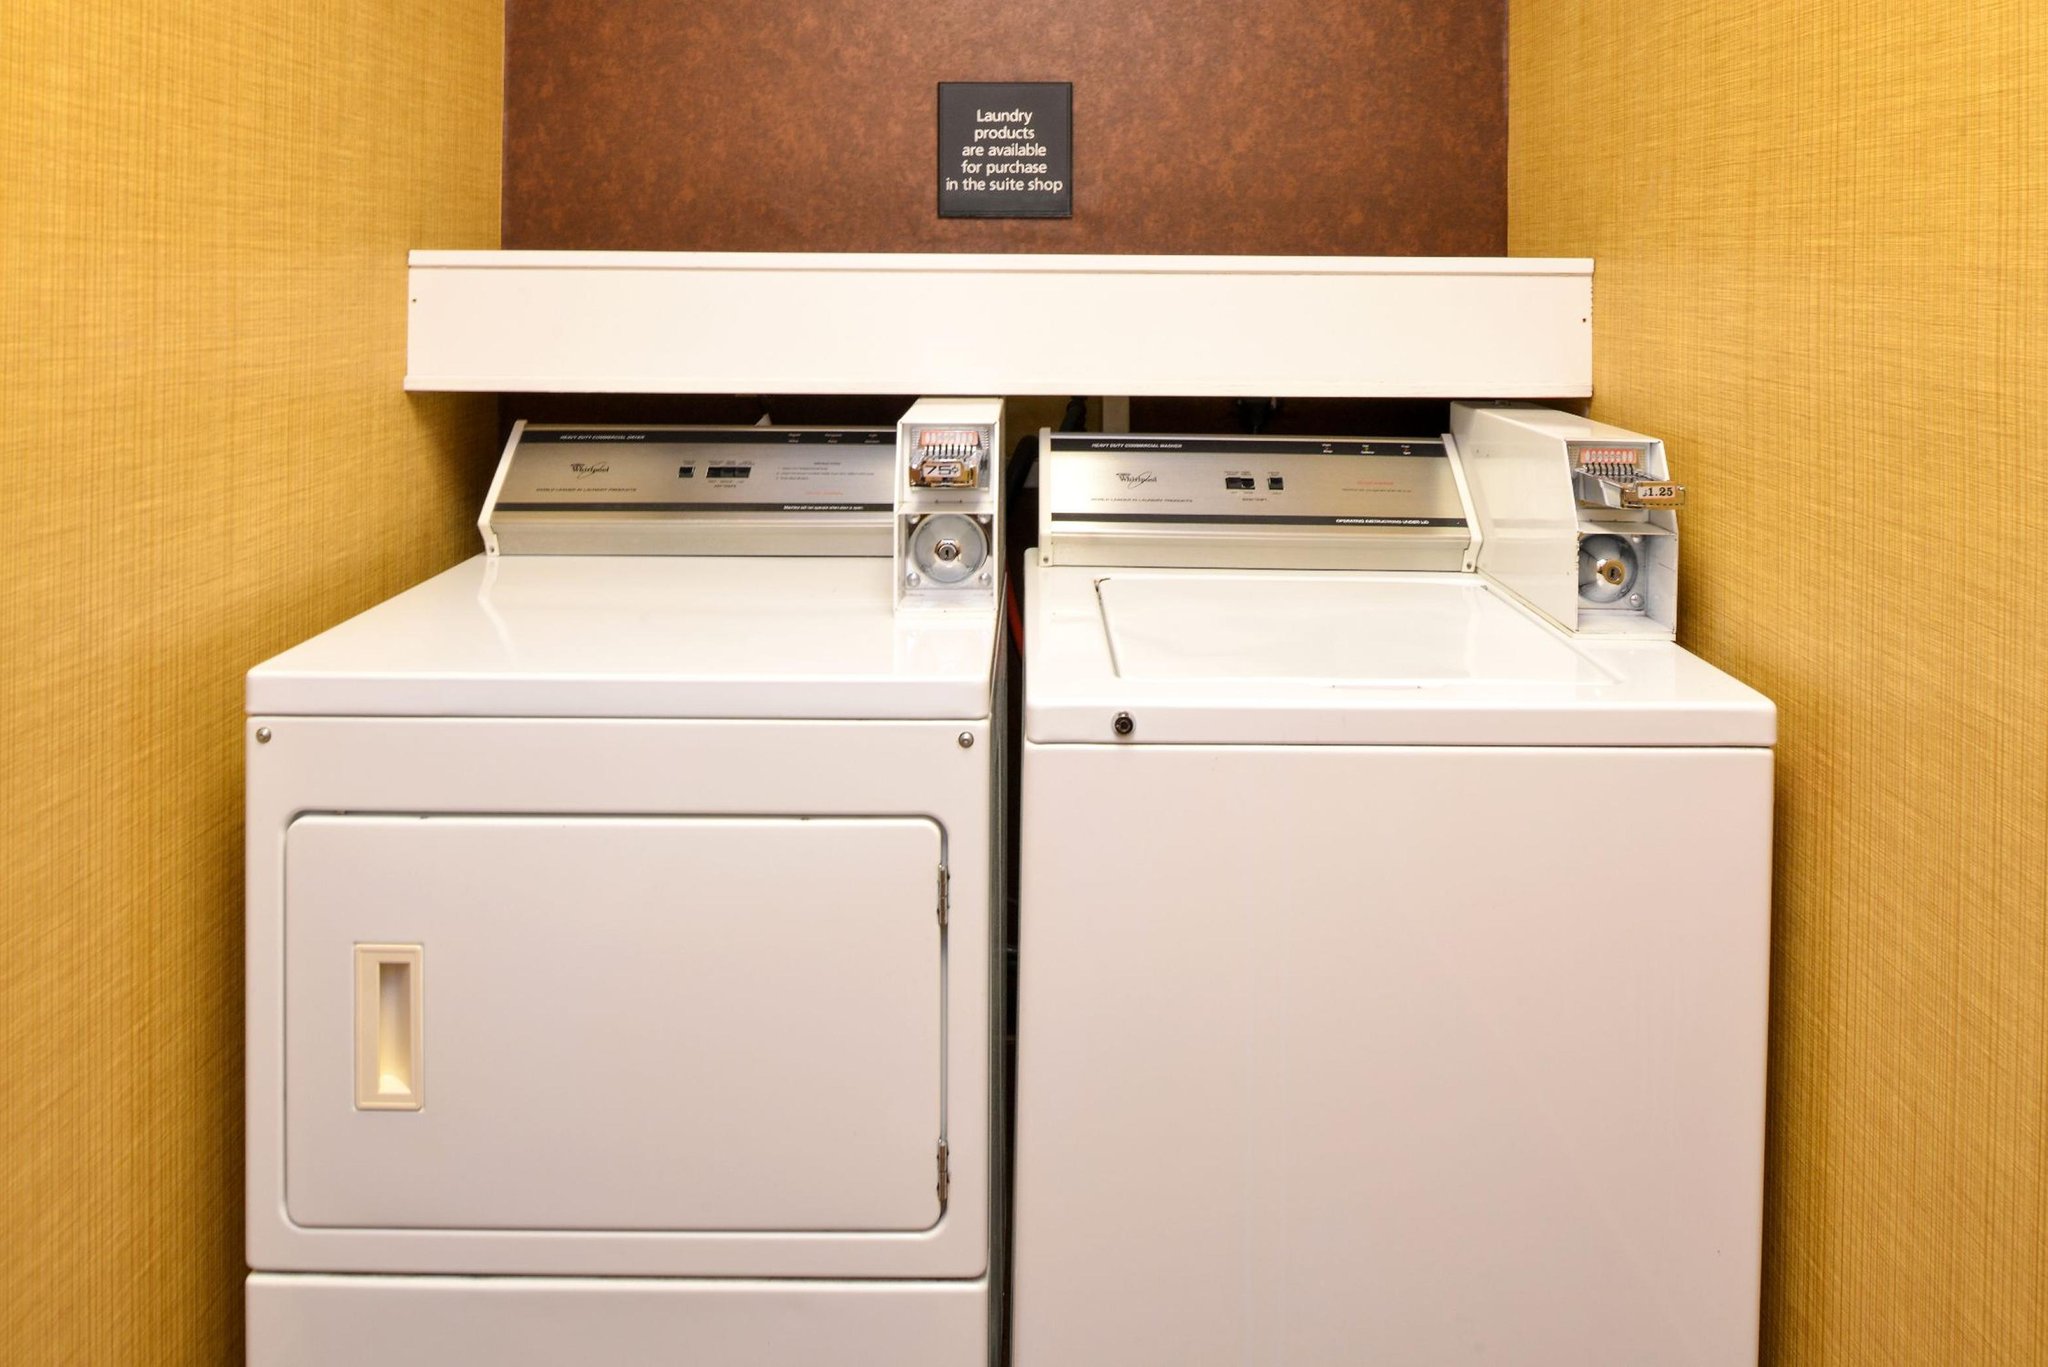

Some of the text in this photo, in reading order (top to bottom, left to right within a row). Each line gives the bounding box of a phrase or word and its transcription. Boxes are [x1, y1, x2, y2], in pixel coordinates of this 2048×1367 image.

[976, 108, 1033, 125] Laundry
[974, 126, 1035, 142] products
[961, 143, 1047, 156] are available
[960, 160, 1048, 176] for purchase
[945, 177, 1063, 194] in the suite shop
